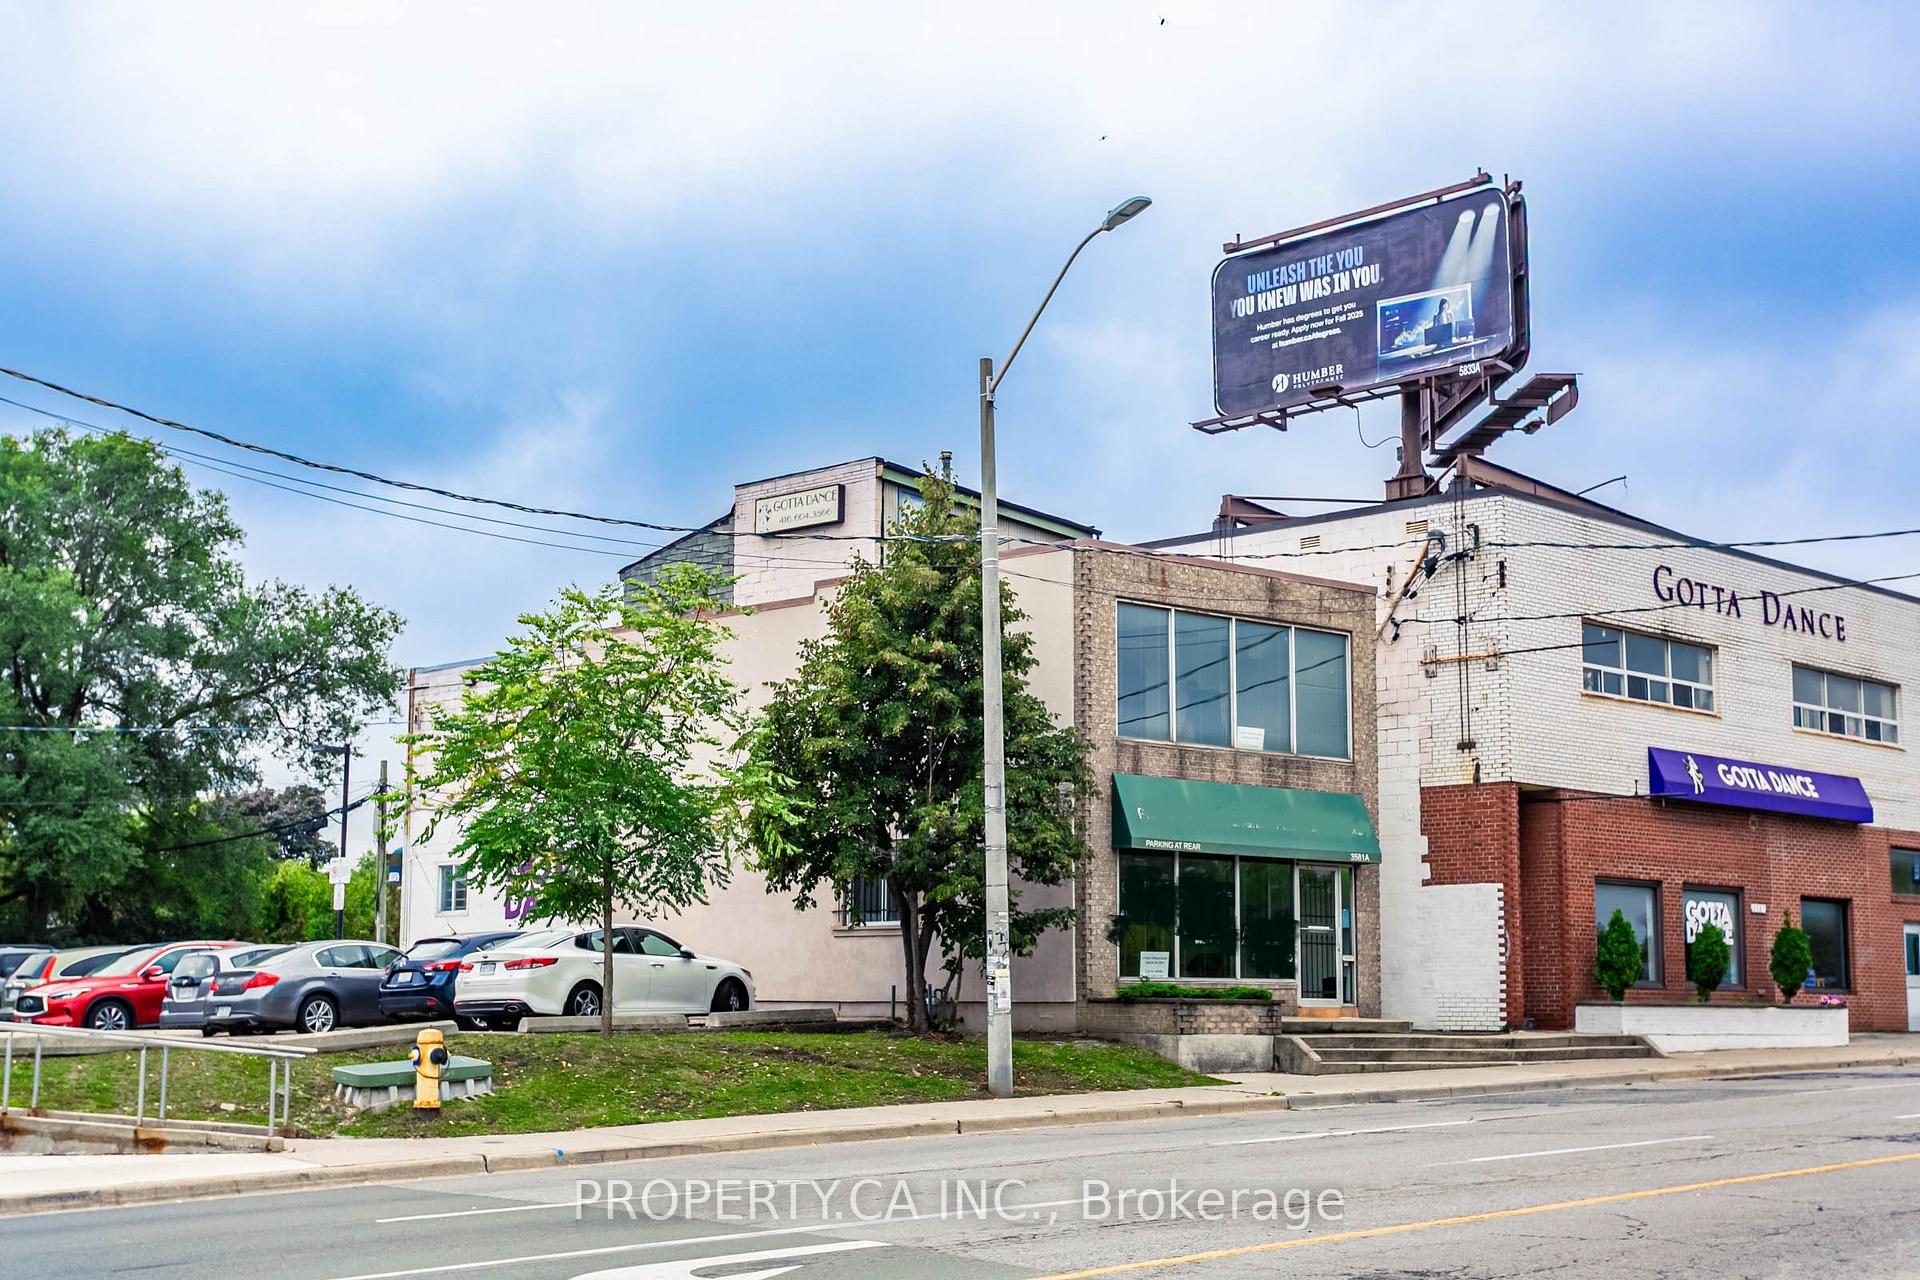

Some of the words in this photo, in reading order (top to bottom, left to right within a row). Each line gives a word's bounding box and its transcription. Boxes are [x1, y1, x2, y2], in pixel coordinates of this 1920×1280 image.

[1247, 262, 1306, 293] UNLEASH
[1309, 253, 1334, 278] THE
[1336, 246, 1363, 271] YOU
[1230, 295, 1254, 319] YOU
[1257, 284, 1297, 313] KNEW
[1299, 276, 1332, 302] WAS
[1333, 271, 1350, 294] IN
[1250, 333, 1271, 344] career
[1291, 323, 1310, 334] Apply
[1310, 320, 1324, 329] now
[1325, 316, 1335, 325] for
[1335, 313, 1347, 323] Fall
[1347, 309, 1364, 321] 2025
[1256, 319, 1282, 331] Humber
[1283, 316, 1295, 325] has
[1296, 310, 1323, 322] degrees
[1331, 304, 1343, 315] get
[1343, 302, 1356, 312] you
[1272, 341, 1279, 349] at
[1293, 363, 1344, 385] HUMBER
[1458, 361, 1481, 377] 5833A
[773, 496, 804, 512] GOTTA
[806, 489, 837, 506] DANCE
[1717, 763, 1772, 792] GOTTA
[1767, 770, 1820, 798] DANCE
[1145, 839, 1174, 849] PARKING
[1174, 841, 1182, 849] AT
[1183, 842, 1201, 851] REAR
[1685, 900, 1733, 928] GOTTA
